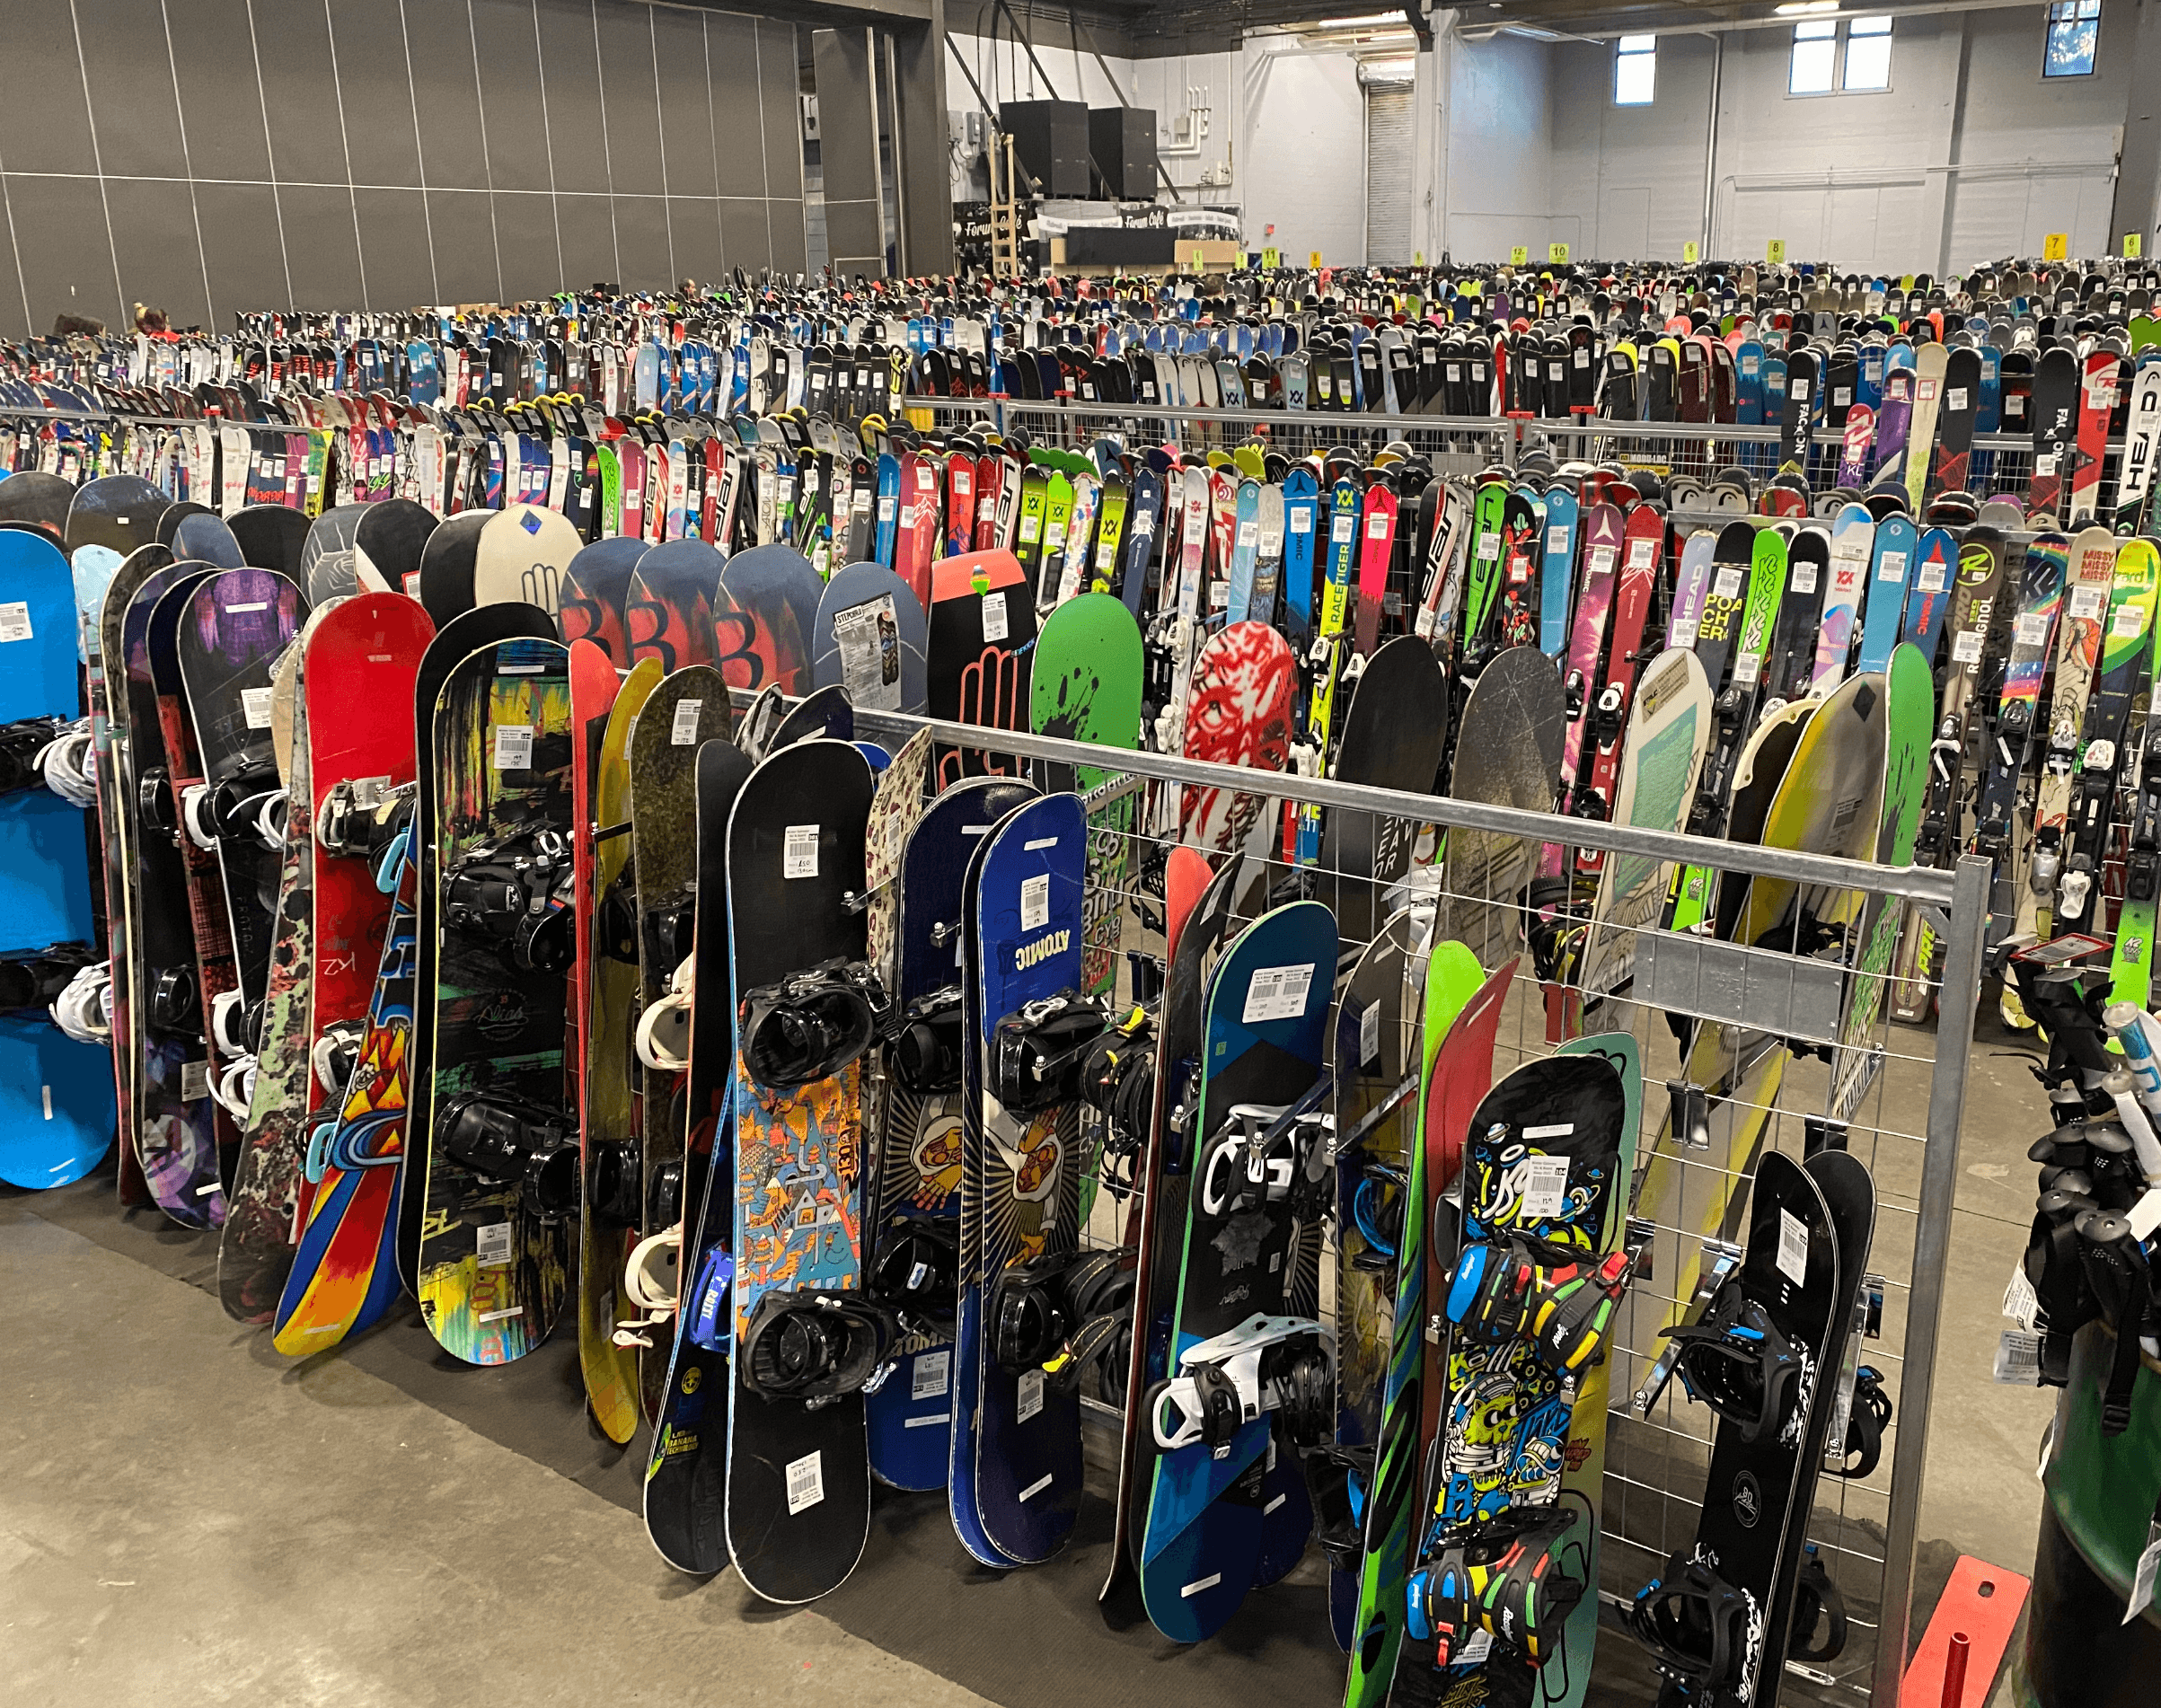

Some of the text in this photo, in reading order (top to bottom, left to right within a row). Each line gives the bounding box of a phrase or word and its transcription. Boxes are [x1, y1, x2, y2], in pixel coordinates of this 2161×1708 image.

[1125, 215, 1148, 229] Forum
[1149, 210, 1165, 228] Café
[1773, 242, 1780, 253] 8
[2052, 238, 2059, 249] 7
[2129, 237, 2135, 247] 6
[1265, 250, 1275, 260] 11
[1554, 246, 1566, 257] 10
[2083, 550, 2114, 560] MISSY
[2081, 560, 2112, 571] MISSY
[2079, 570, 2112, 582] MISSY
[1706, 593, 1743, 612] POA
[1702, 608, 1730, 627] CH
[1015, 929, 1071, 972] ATOMIC
